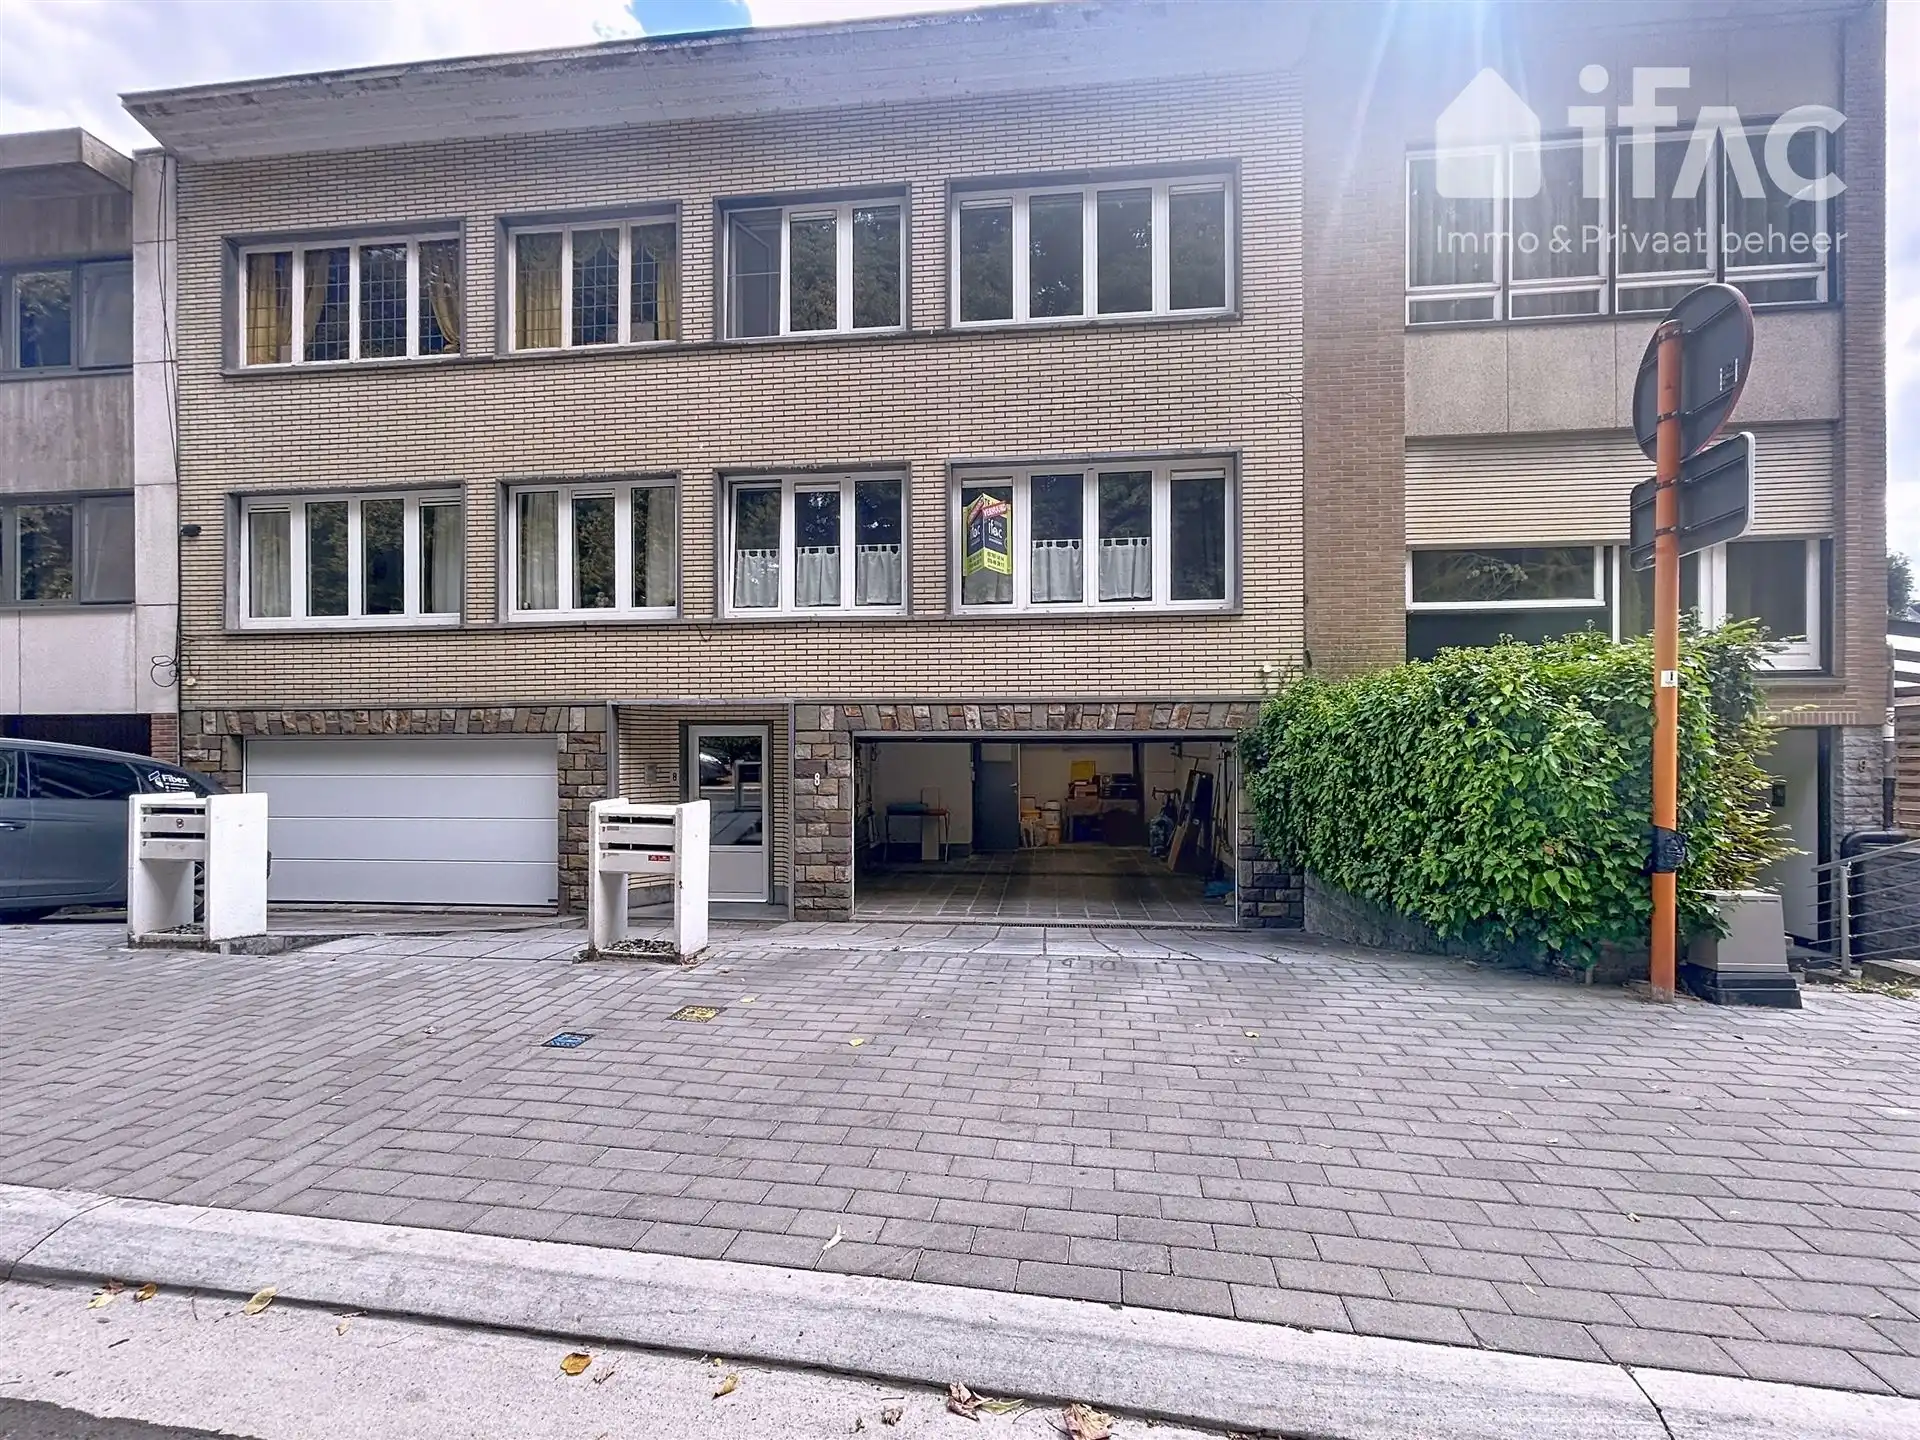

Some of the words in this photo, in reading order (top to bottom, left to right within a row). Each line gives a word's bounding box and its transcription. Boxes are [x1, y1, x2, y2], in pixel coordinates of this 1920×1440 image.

[673, 772, 678, 782] 8
[814, 772, 821, 786] 8
[176, 818, 184, 828] 8
